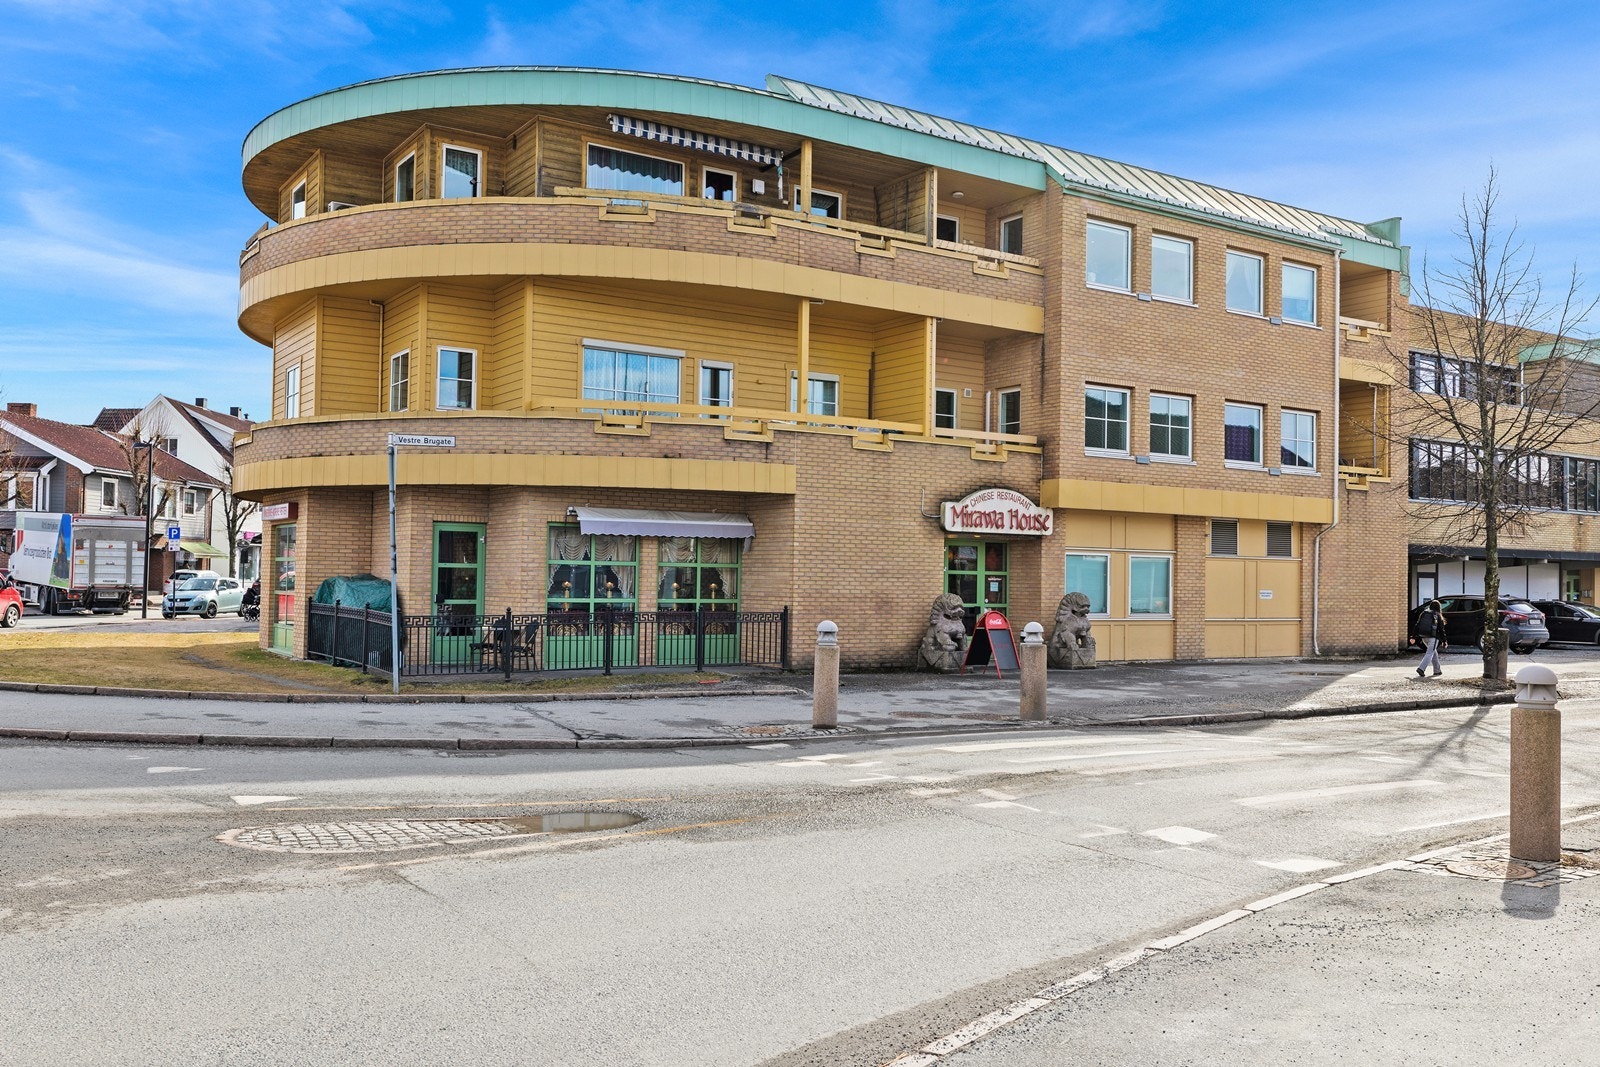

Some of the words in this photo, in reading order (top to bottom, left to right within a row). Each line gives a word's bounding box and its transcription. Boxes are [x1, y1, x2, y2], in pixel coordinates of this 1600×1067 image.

[398, 436, 421, 444] Vestre
[424, 437, 451, 445] Brugate
[970, 491, 994, 507] CHINESE
[997, 491, 1032, 510] RESTAURANT
[951, 504, 1005, 529] Mirawa
[1008, 508, 1050, 531] House
[171, 528, 179, 539] P
